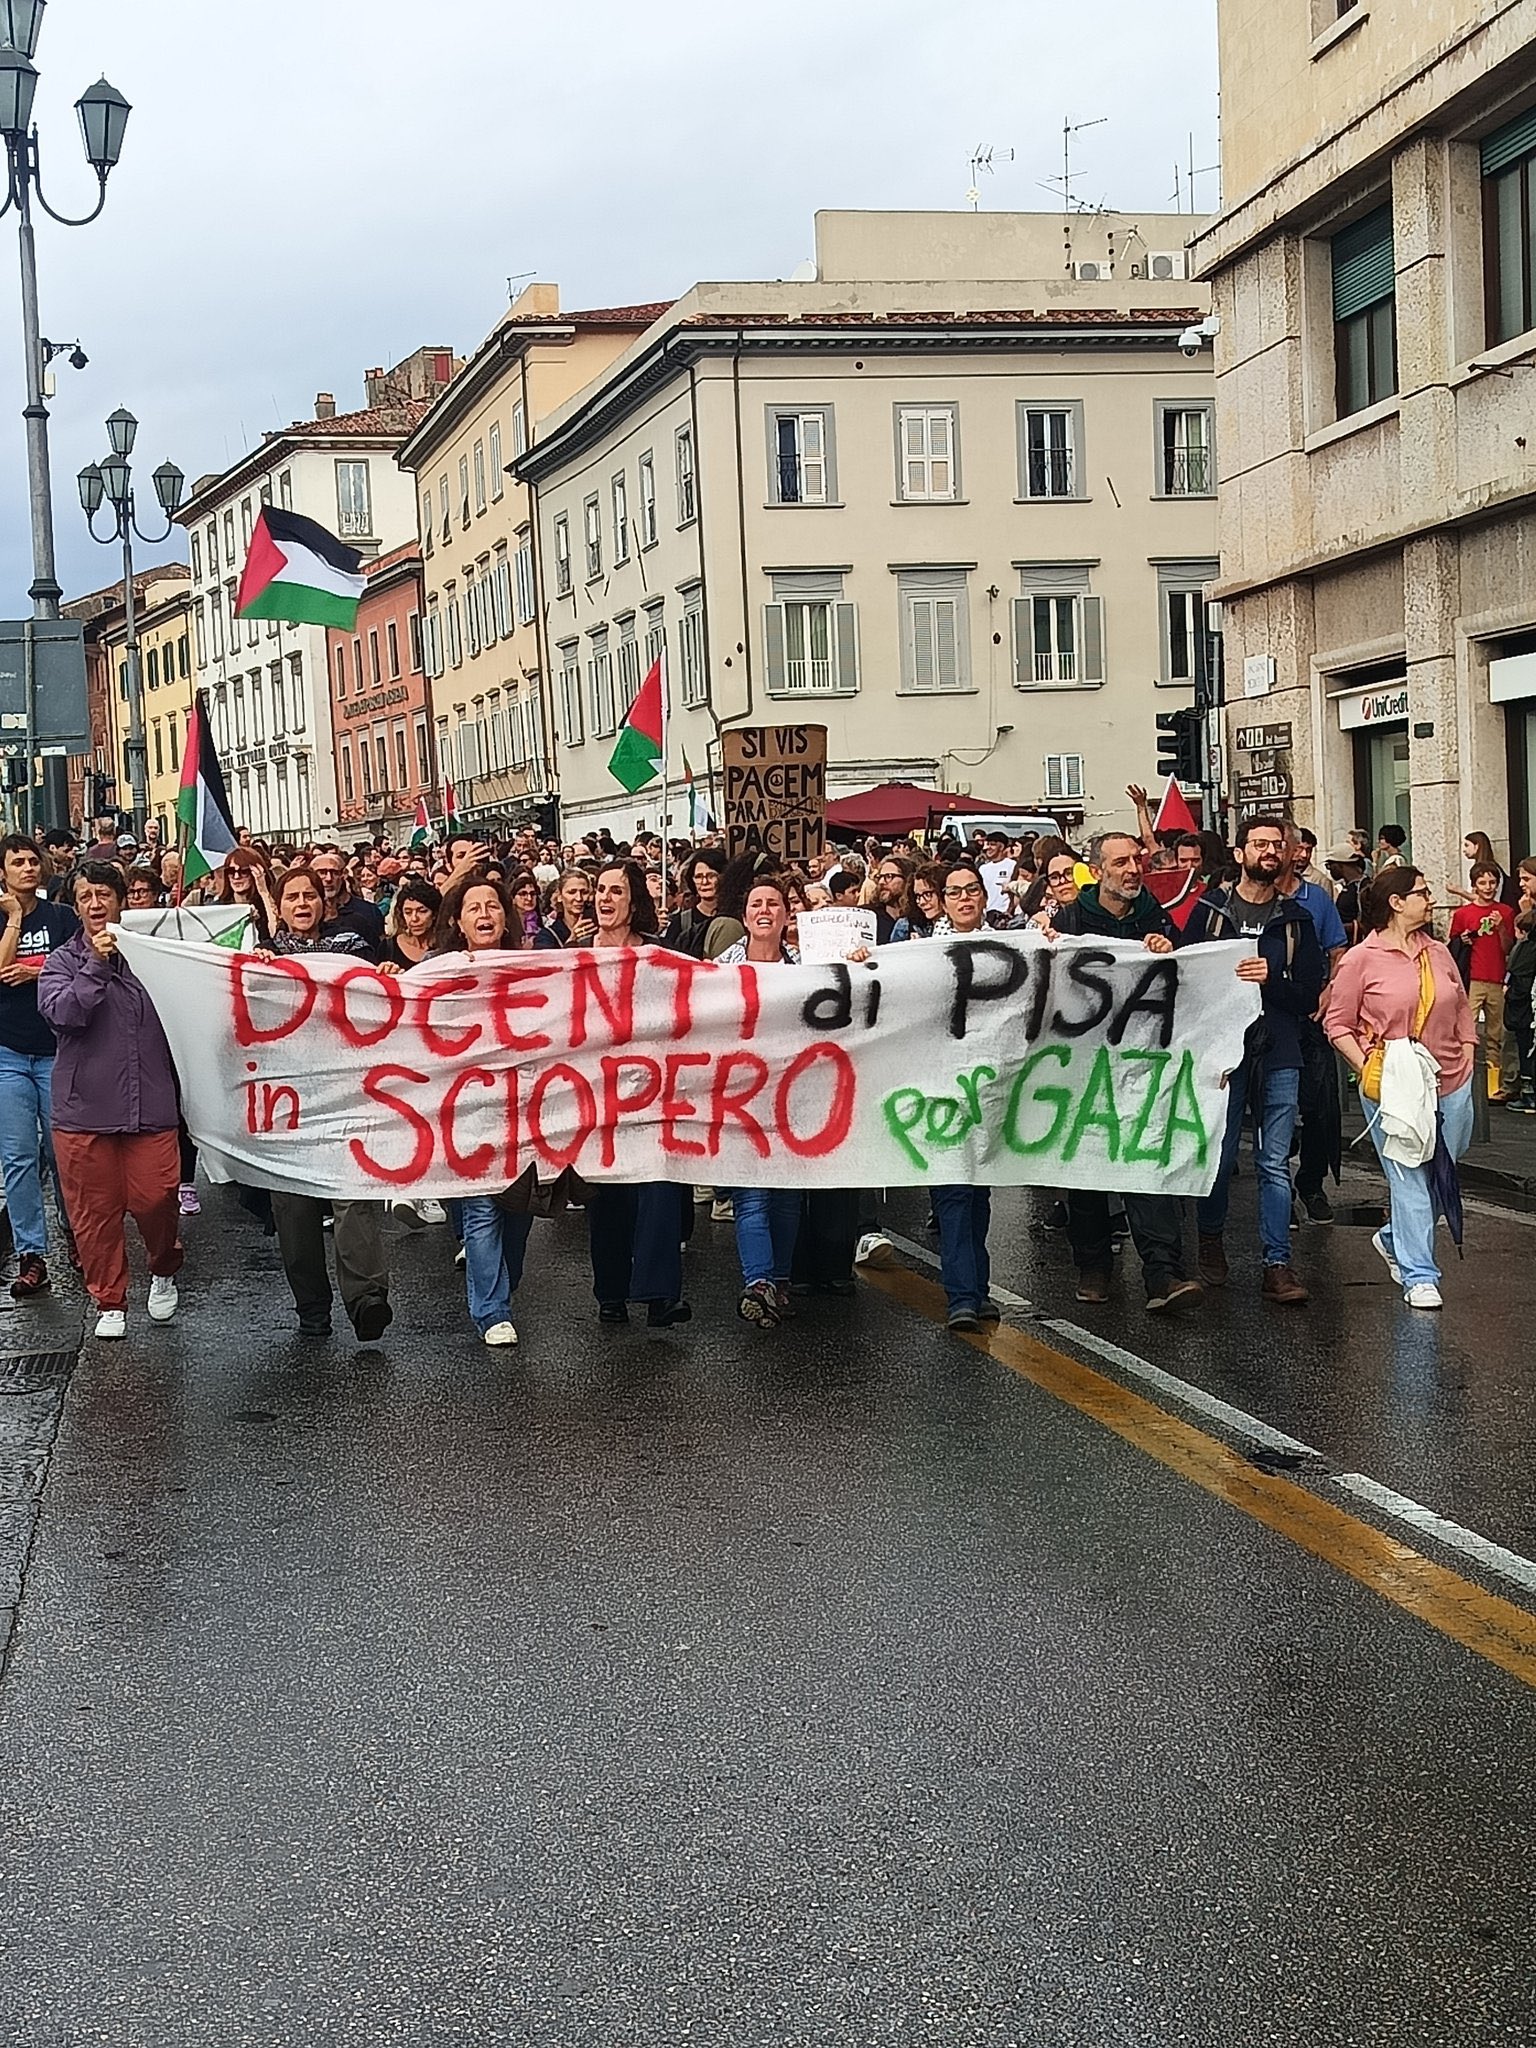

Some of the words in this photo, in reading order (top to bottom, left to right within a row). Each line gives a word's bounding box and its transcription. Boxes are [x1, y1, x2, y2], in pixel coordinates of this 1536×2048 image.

[1371, 691, 1409, 718] UniCredit
[742, 729, 766, 759] SI
[775, 727, 808, 755] VIS
[727, 763, 823, 800] PACEM
[725, 799, 767, 824] PARA
[728, 817, 823, 860] PACEM
[18, 926, 51, 948] ggi
[231, 946, 760, 1057] DOCENTI
[801, 962, 881, 1030] di
[945, 940, 1180, 1048] PISA
[246, 1062, 300, 1134] in
[349, 1041, 856, 1184] SCIOPERO
[883, 1065, 997, 1170] per
[1003, 1045, 1208, 1168] GAZA
